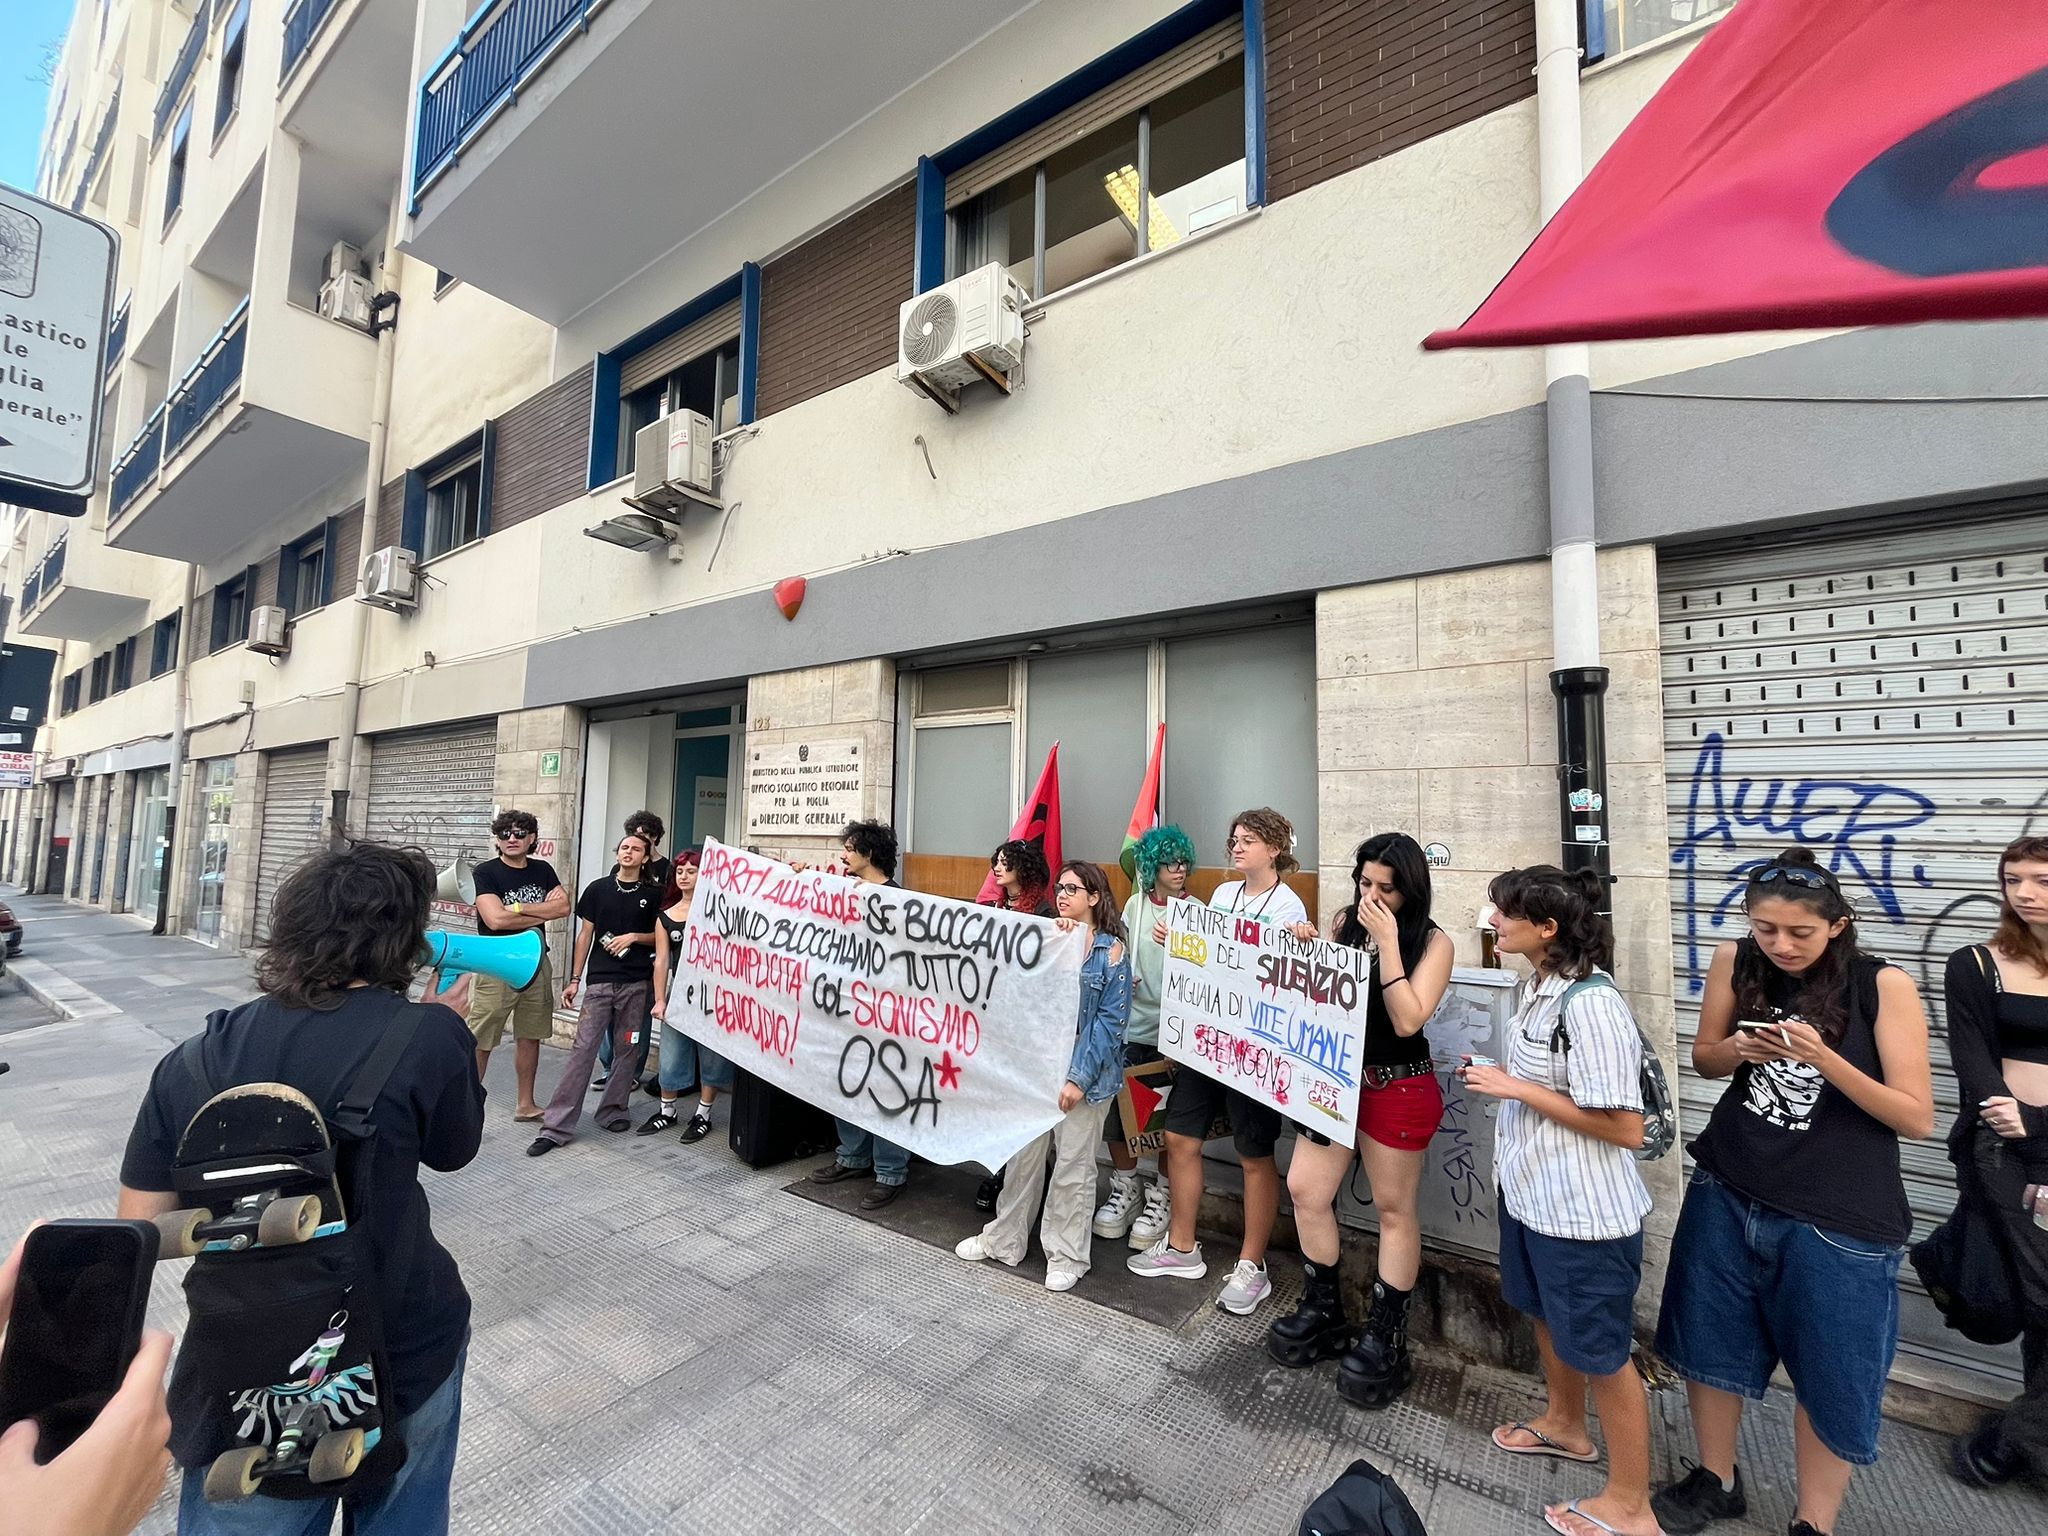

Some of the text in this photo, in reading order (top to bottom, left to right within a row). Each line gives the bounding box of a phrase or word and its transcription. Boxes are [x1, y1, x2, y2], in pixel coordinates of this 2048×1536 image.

[0, 313, 87, 350] astico
[751, 780, 859, 794] UFFICIO SCOLASTICO REGIONALE
[752, 763, 859, 777] MINISTERO DELLA PUBBLICA ISTRUZIONE
[759, 812, 846, 825] DIREZIONE GENERALE
[774, 796, 830, 807] PER LA PUGLIA
[762, 879, 810, 911] ALLE
[866, 893, 897, 936] SE
[904, 898, 1044, 970] BLOCCANO
[1170, 900, 1368, 984] MENTRE NOI CI PRENDIAMO IL
[718, 893, 770, 941] SUMUD
[768, 918, 886, 979] BLOCCHIAMO
[890, 950, 999, 1011] TUTTO!
[1169, 930, 1359, 1013] LUSSO DEL SILENZIO
[687, 925, 723, 976] BASTA
[812, 972, 851, 1018] COL
[851, 980, 980, 1057] SIONISMO
[700, 980, 714, 1016] IL
[1166, 1014, 1185, 1050] SI
[1167, 971, 1355, 1077] MIGLIAIA DI VITE UMANE
[1307, 1089, 1338, 1111] GAZA
[1128, 1131, 1166, 1154] PALE
